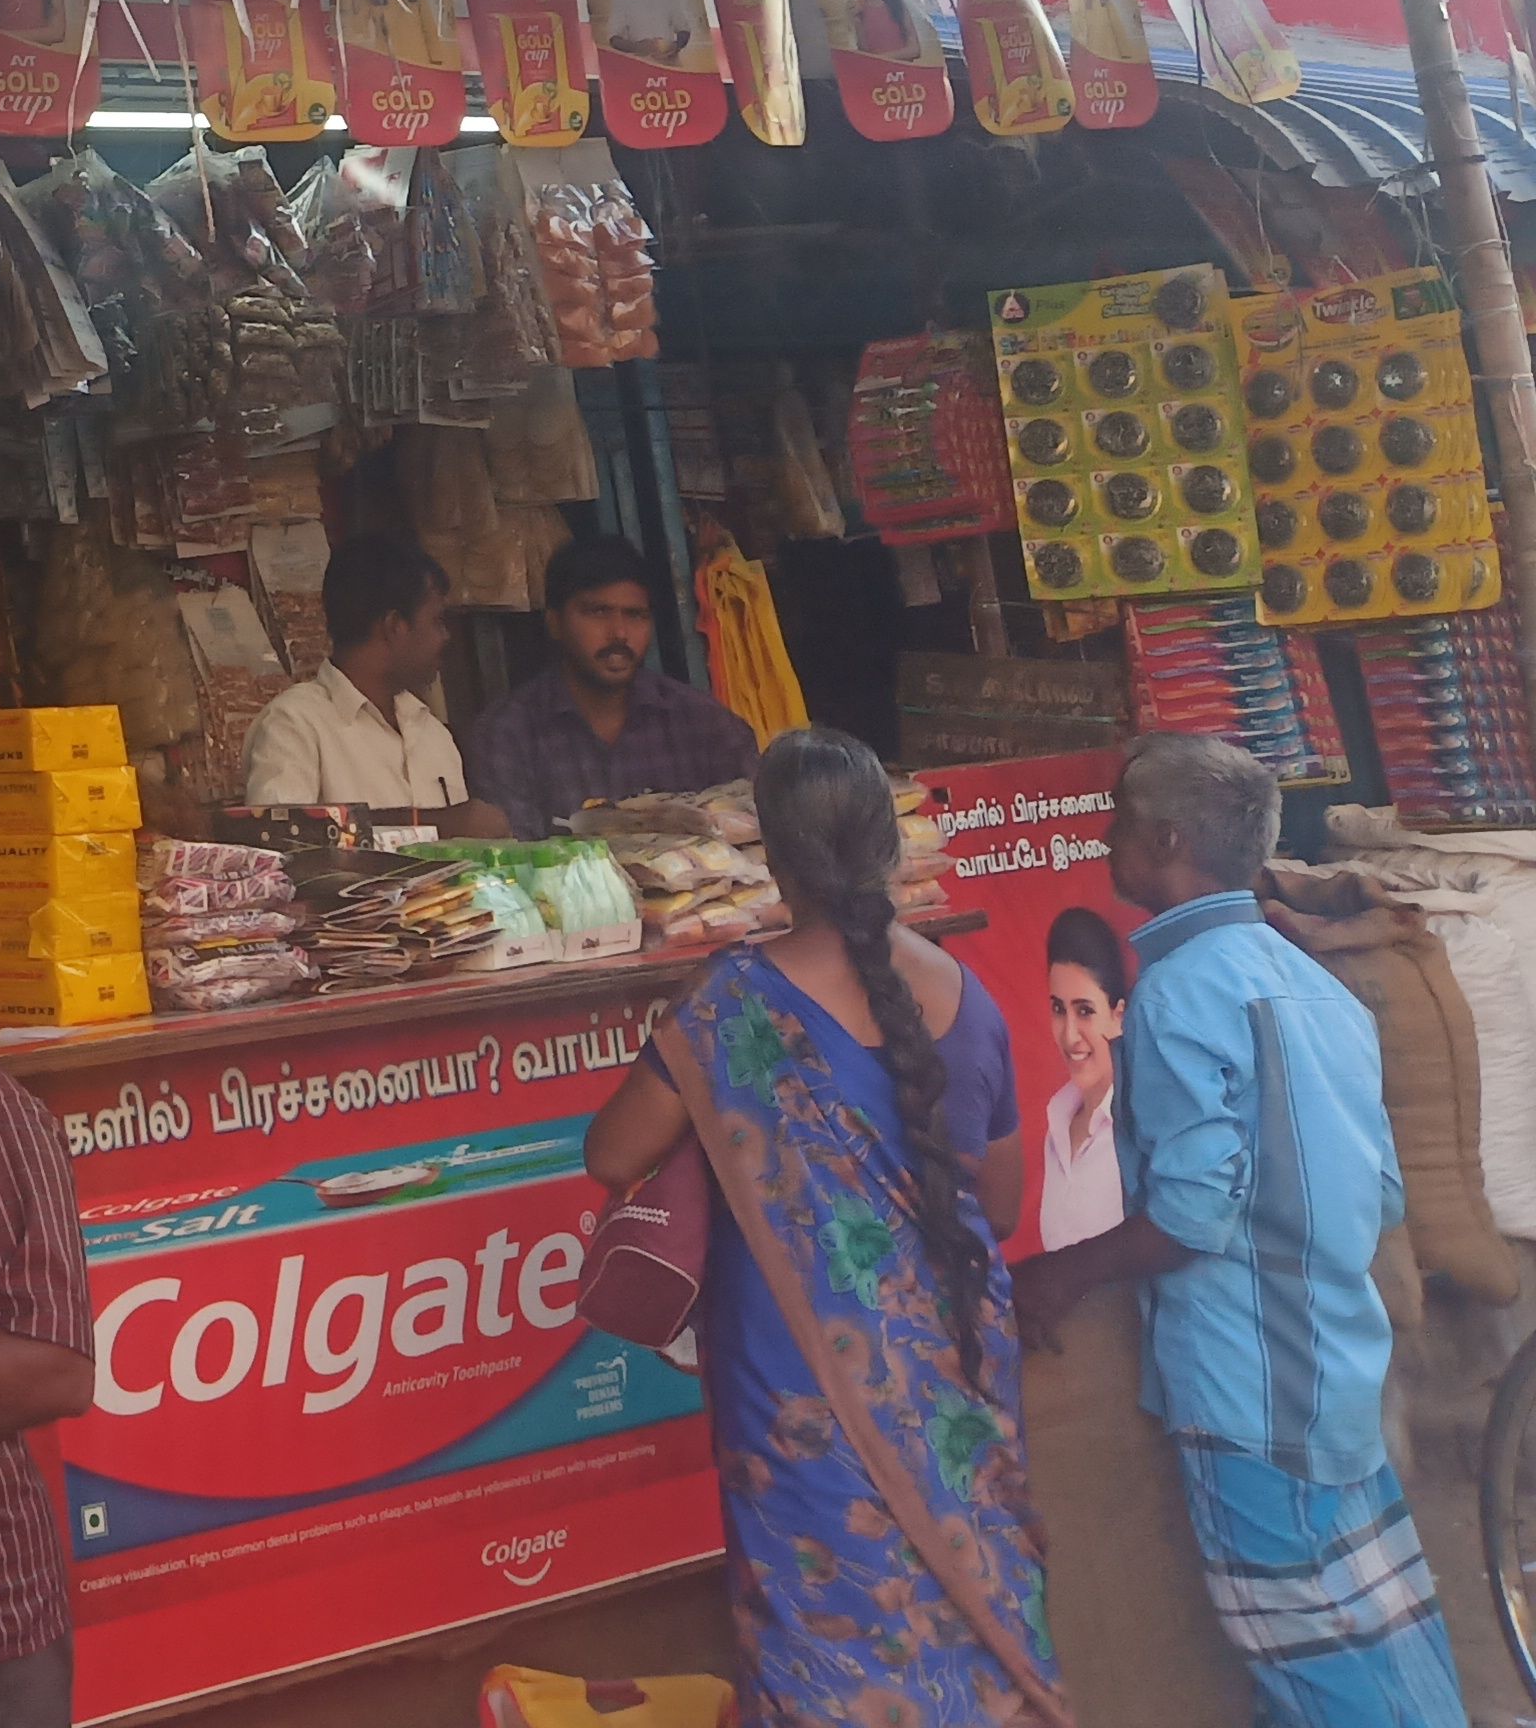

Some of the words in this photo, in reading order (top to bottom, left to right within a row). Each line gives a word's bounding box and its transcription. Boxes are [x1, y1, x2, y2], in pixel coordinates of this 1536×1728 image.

[252, 23, 285, 39] OLD
[516, 32, 553, 51] GOLD
[524, 49, 550, 69] cup
[372, 90, 435, 112] GOLD
[630, 91, 692, 113] GOLD
[871, 85, 927, 106] GOLD
[1083, 80, 1128, 100] GOLD
[640, 110, 688, 139] cup
[883, 103, 924, 131] cup
[1089, 98, 1126, 124] cup
[381, 111, 430, 141] cup
[1314, 293, 1376, 318] Twinkle
[955, 838, 1047, 878] வாய்ப்பே
[0, 1004, 56, 1016] EXPORT
[65, 1079, 192, 1156] களில்
[208, 1034, 502, 1137] பிரச்சனையா?
[79, 1186, 239, 1222] Colgate
[134, 1200, 266, 1245] Salt
[91, 1226, 586, 1416] Colgate
[382, 1369, 449, 1398] Anticavity
[451, 1353, 523, 1385] Toothpaste
[575, 1400, 624, 1422] PROBLEMS
[79, 1573, 122, 1593] Creative
[123, 1557, 188, 1584] visualisation.
[189, 1548, 221, 1569] Fights
[222, 1541, 266, 1561] common
[266, 1533, 298, 1551] dental
[299, 1520, 344, 1546] problems
[344, 1513, 366, 1530] such
[367, 1512, 379, 1526] as
[415, 1498, 433, 1513] bad
[433, 1489, 464, 1508] breath
[465, 1484, 483, 1499] and
[480, 1527, 570, 1568] Colgate
